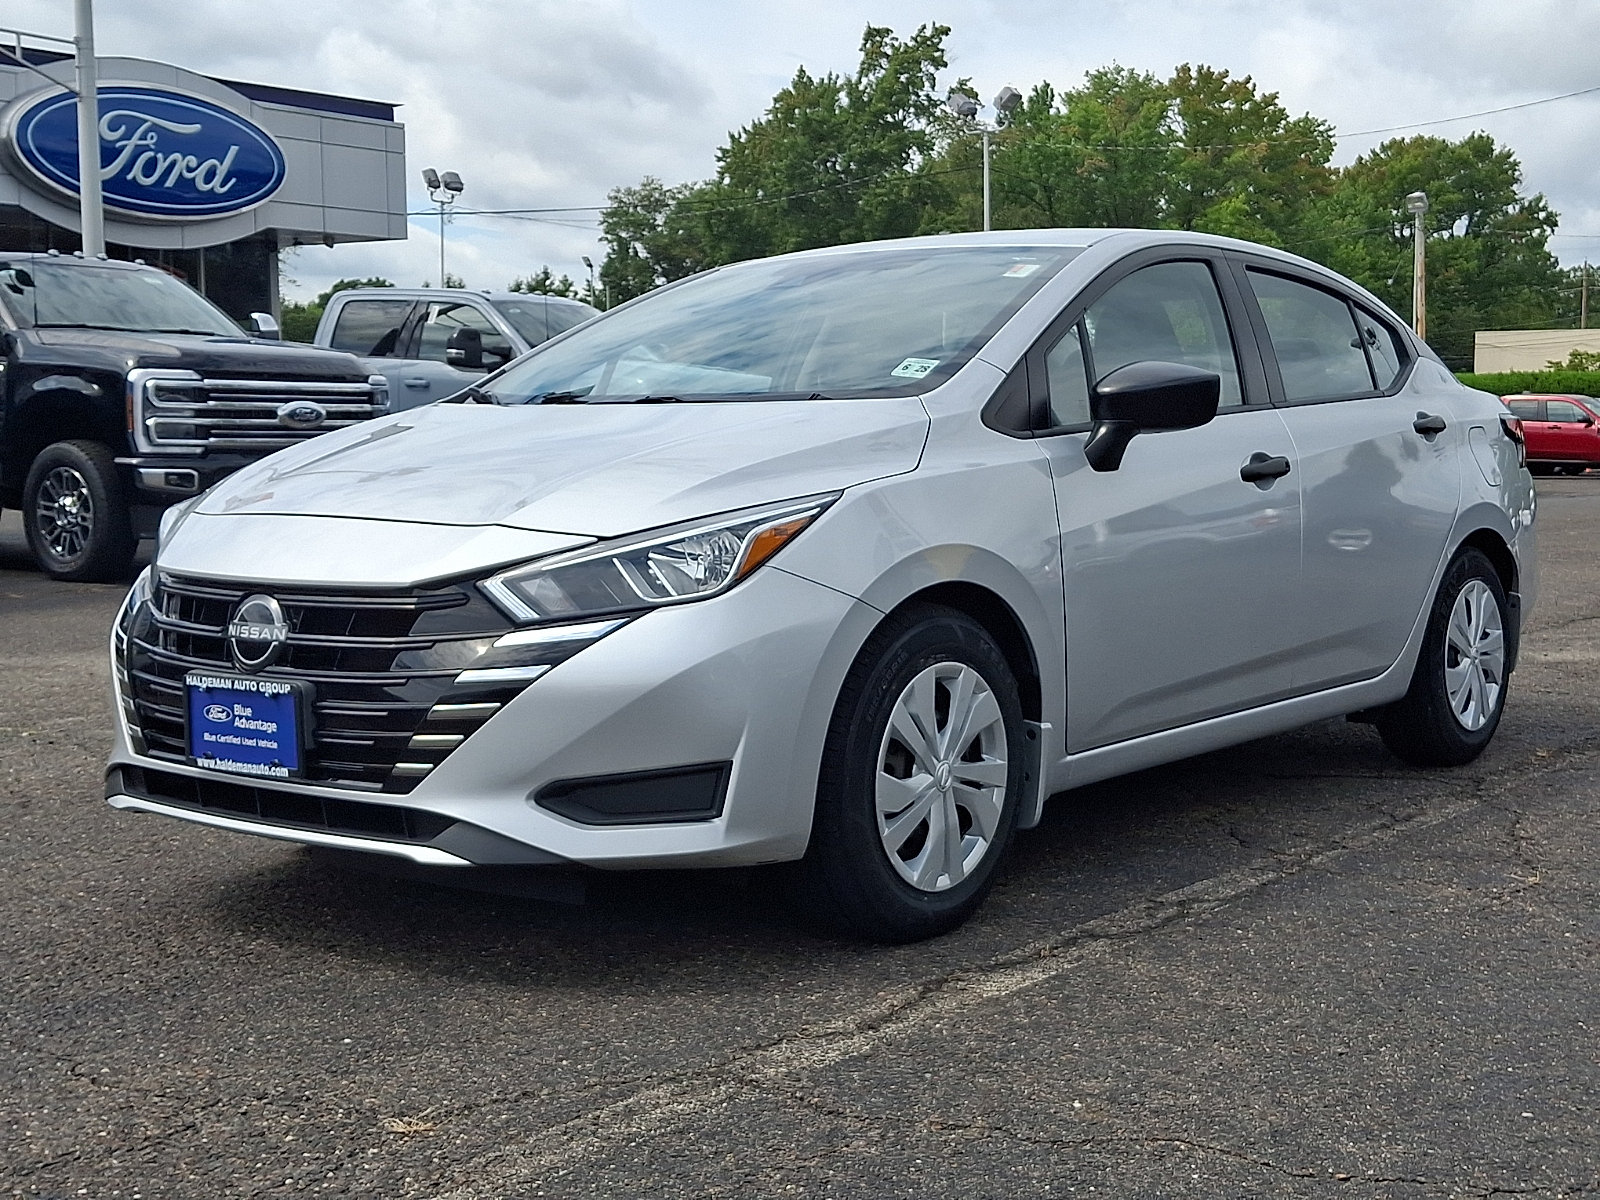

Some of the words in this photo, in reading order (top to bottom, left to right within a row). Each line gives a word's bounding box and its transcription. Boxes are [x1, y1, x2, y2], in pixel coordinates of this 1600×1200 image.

[99, 110, 240, 194] Ford
[227, 624, 287, 640] NISSAN
[185, 675, 232, 689] HALDEMAN
[233, 679, 258, 692] AUTO
[258, 682, 291, 694] GROUP
[233, 704, 253, 717] Blue
[233, 716, 278, 734] Advantage
[203, 732, 217, 741] Blue
[216, 734, 241, 745] Certified
[241, 737, 257, 747] Used
[257, 739, 278, 749] Vehicle
[196, 757, 289, 778] www.haldemanauto.com
